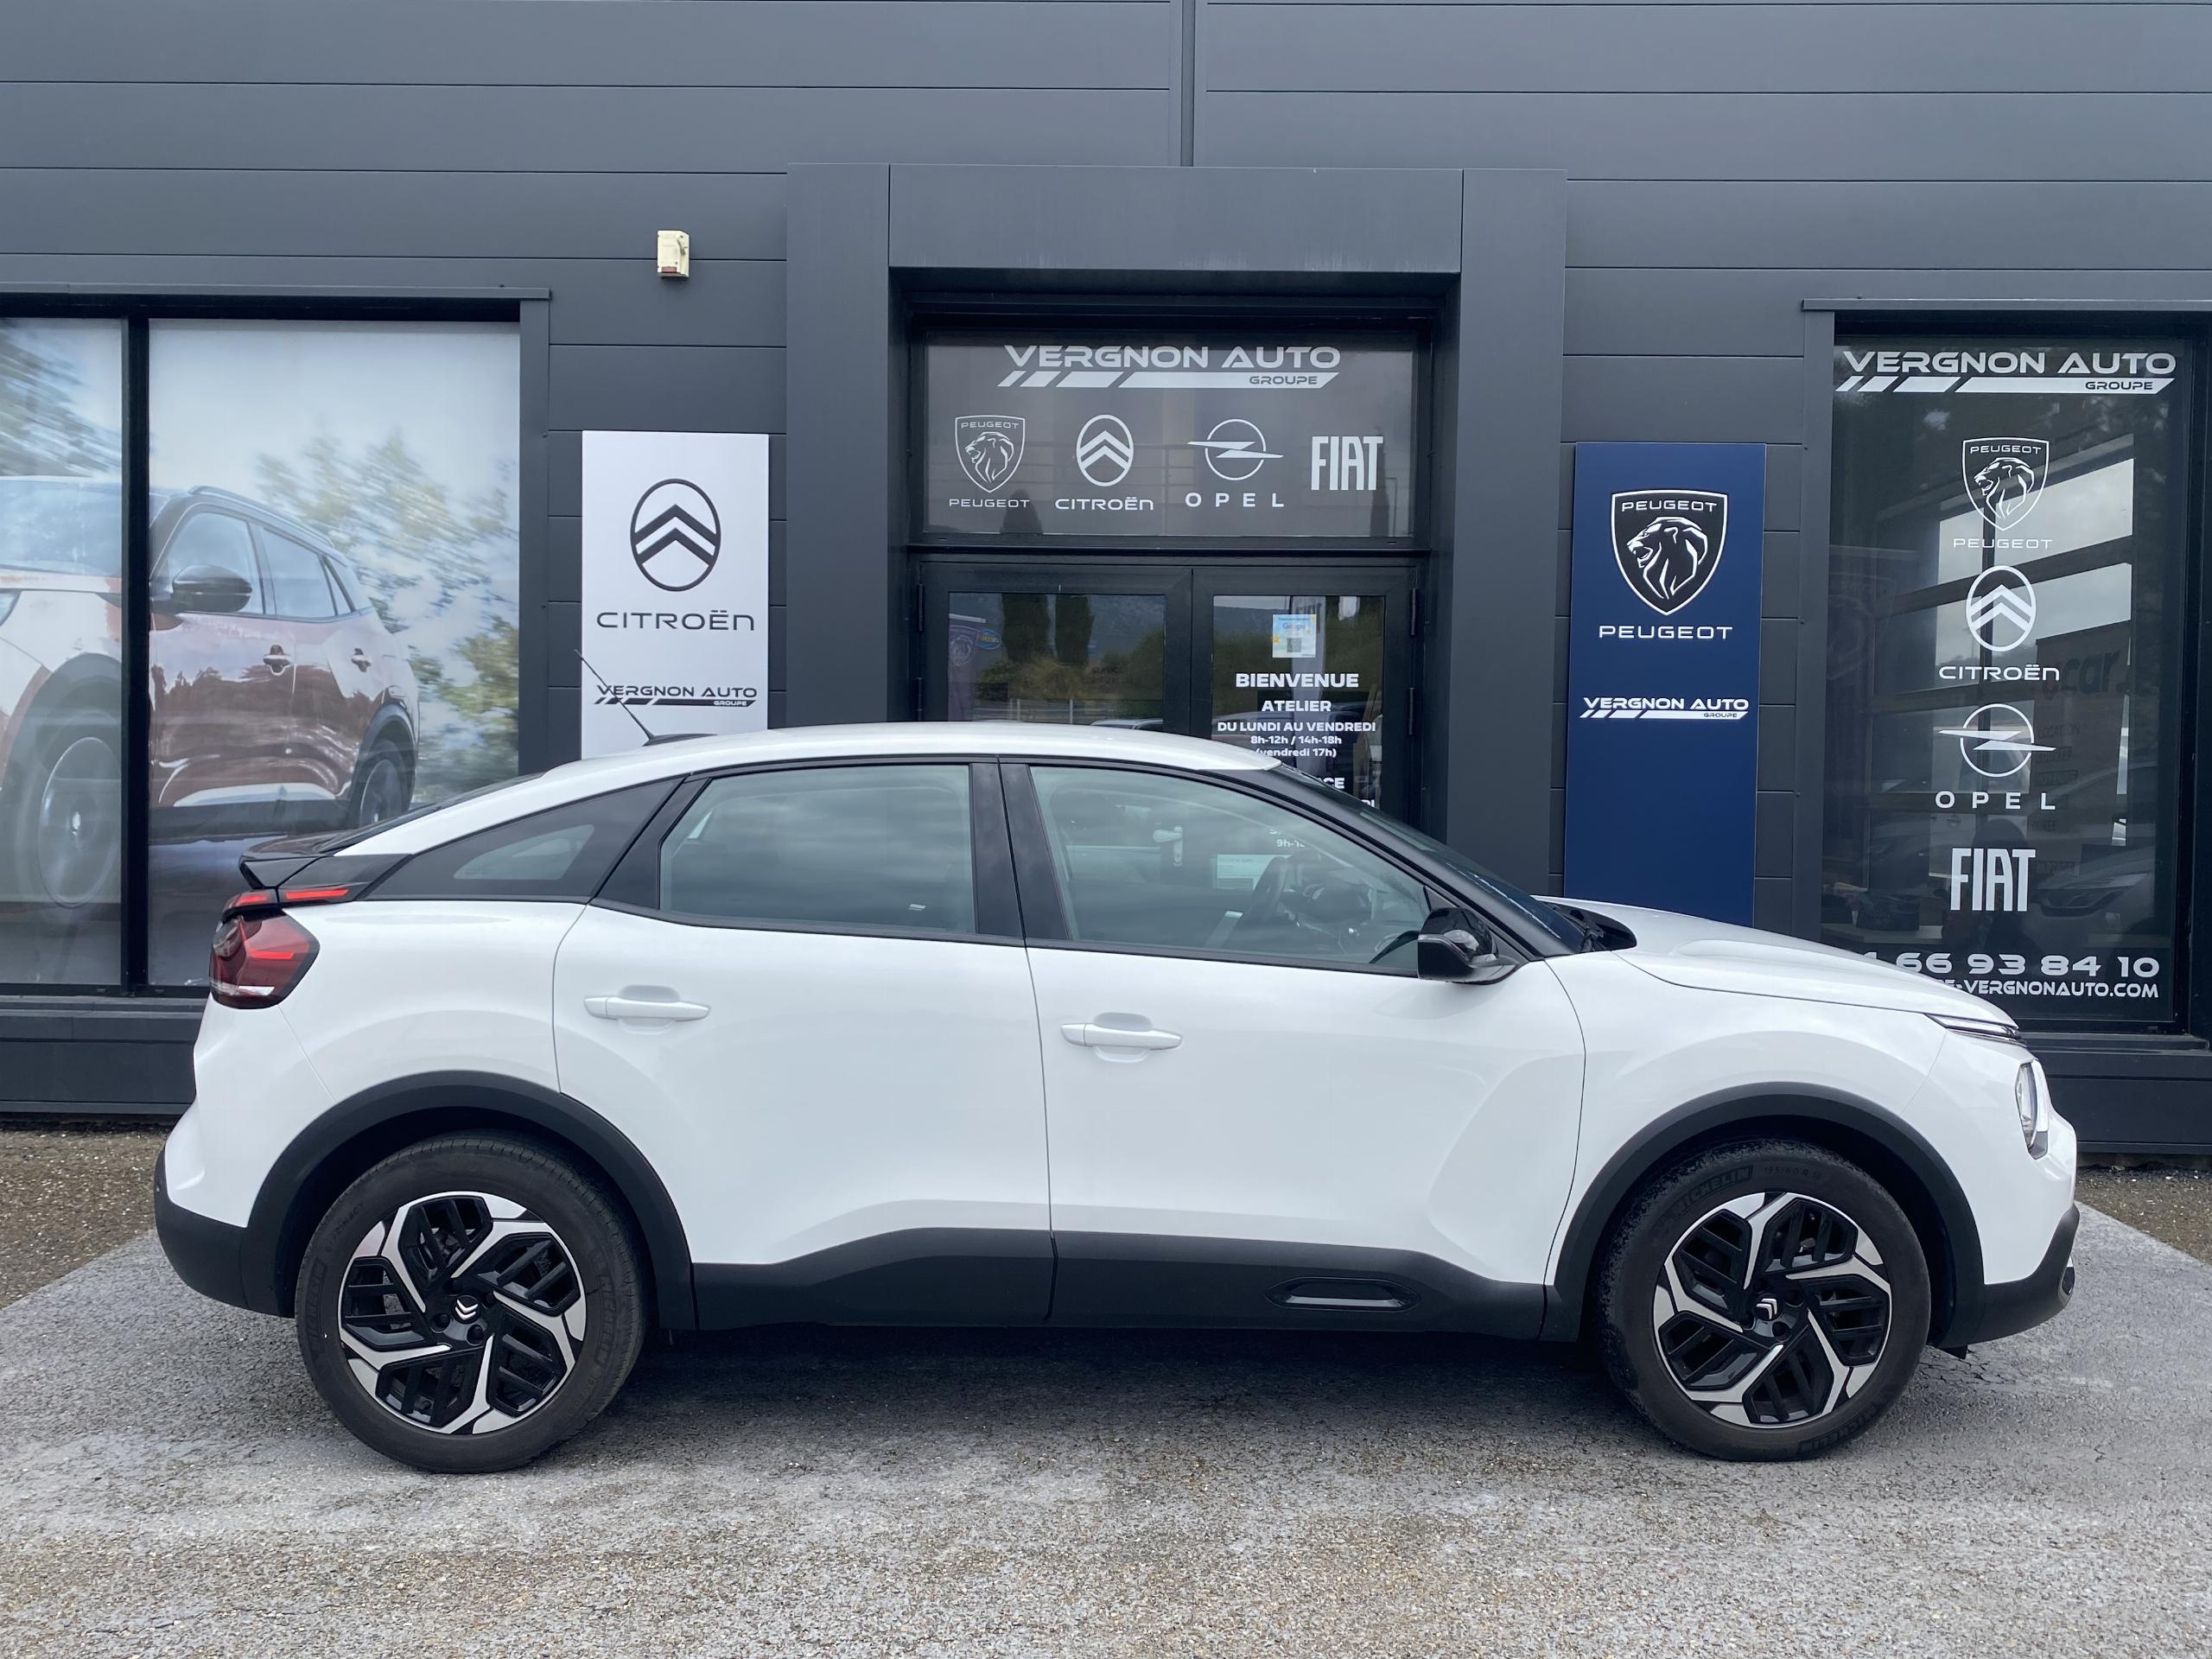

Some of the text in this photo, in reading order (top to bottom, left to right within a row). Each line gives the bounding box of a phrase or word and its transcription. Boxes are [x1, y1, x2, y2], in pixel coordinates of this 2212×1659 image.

[1004, 345, 1341, 370] VERGNON AUTO
[1842, 350, 2177, 375] VERGNON AUTO
[1249, 375, 1319, 386] GROUPE
[2085, 380, 2154, 391] GROUPE
[961, 420, 1020, 429] PEUGEOT
[1969, 443, 2043, 455] PEUGEOT
[1312, 435, 1384, 492] FIAT
[949, 498, 1032, 509] PEUGEOT
[1054, 496, 1154, 511] CITROËN
[1185, 492, 1286, 508] OPEL
[1621, 499, 1719, 513] PEUGEOT
[1952, 537, 2053, 550] PEUGEOT
[596, 609, 755, 632] CITROËN
[1599, 625, 1733, 640] PEUGEOT
[1937, 661, 2061, 682] CITROËN
[1236, 672, 1360, 689] BIENVENUE
[596, 683, 758, 700] VERGNON AUTO
[713, 698, 748, 707] GROUPE
[1261, 700, 1333, 713] ATELIER
[1583, 697, 1751, 712] VERGNON AUTO
[1702, 710, 1738, 719] GROUPE
[1217, 721, 1377, 733] DU LUNDI AU VENDREDI
[1250, 734, 1343, 747] 8h-12h / 14h-18h
[1255, 747, 1338, 759] (vendredi 17h)
[1935, 791, 2056, 811] OPEL
[1949, 848, 2037, 912] FIAT
[1896, 952, 2161, 978] 66 93 84 10
